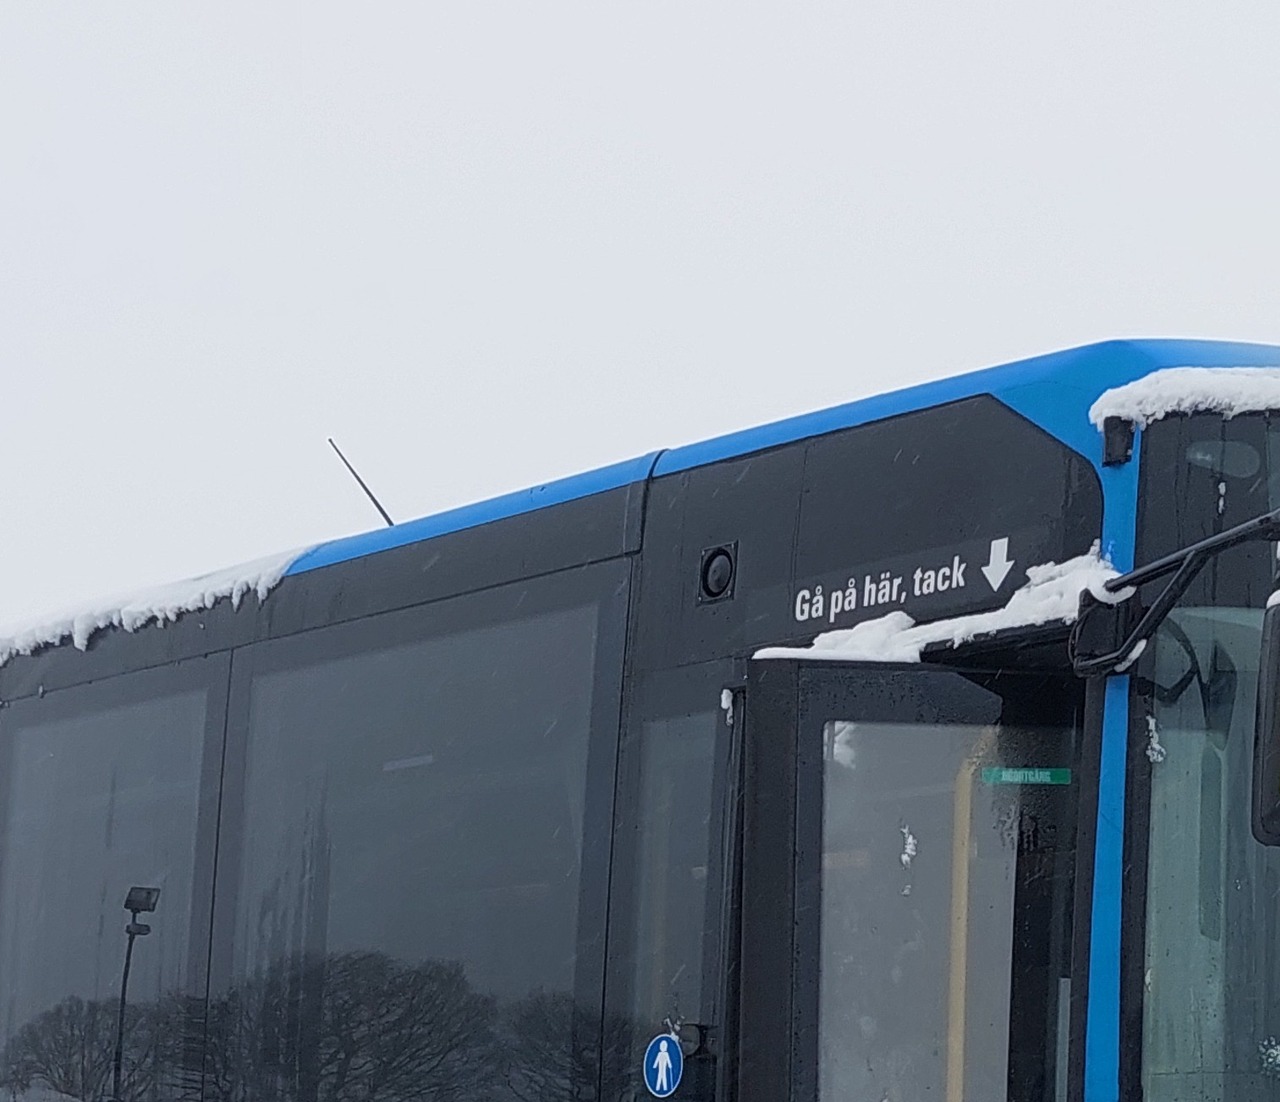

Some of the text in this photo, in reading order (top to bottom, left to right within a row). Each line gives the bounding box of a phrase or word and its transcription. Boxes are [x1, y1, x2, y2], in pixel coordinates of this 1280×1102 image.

[795, 555, 967, 623] Gå på här, tack
